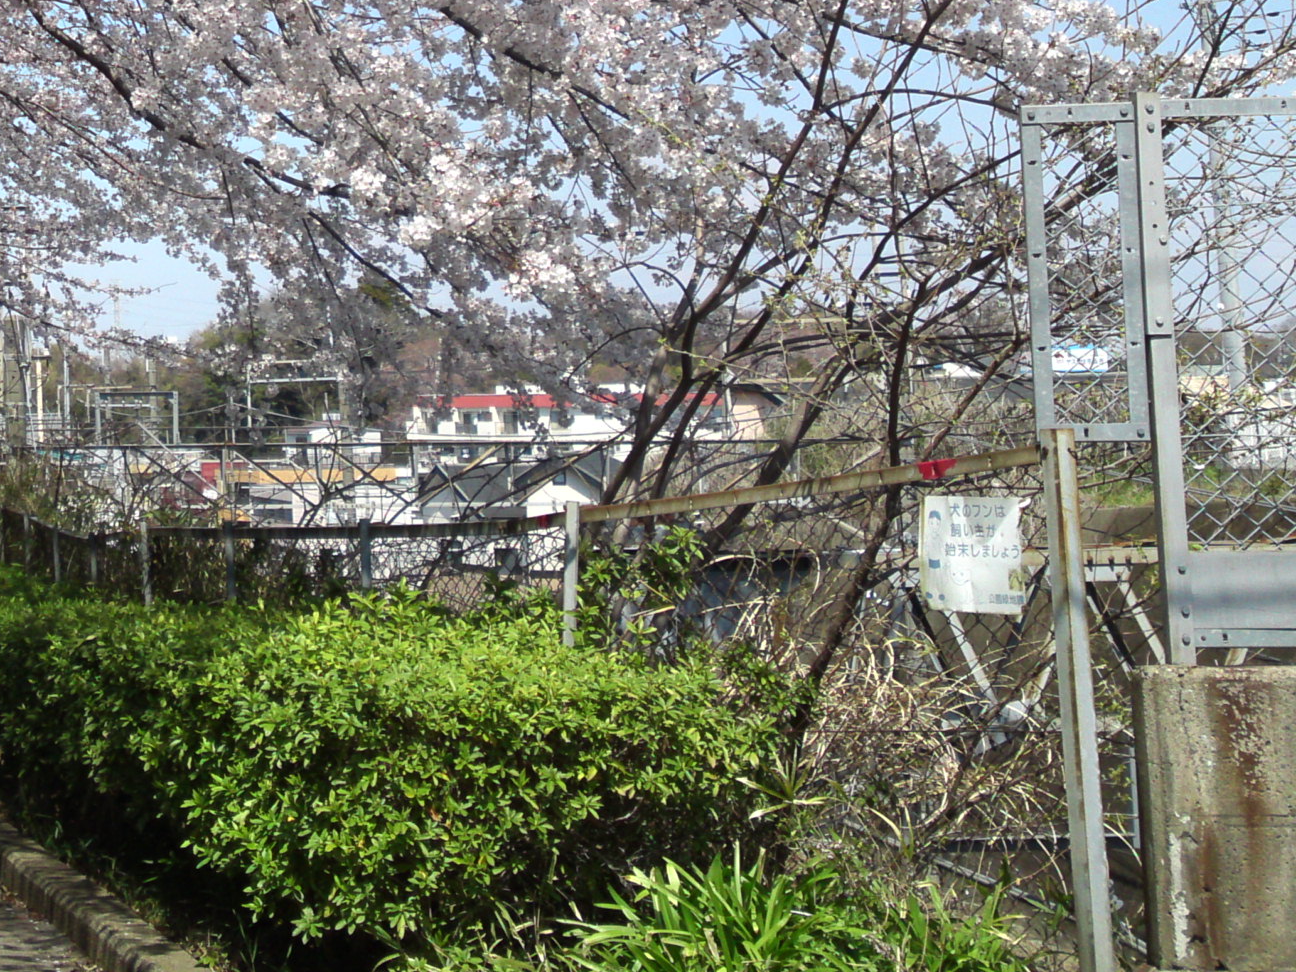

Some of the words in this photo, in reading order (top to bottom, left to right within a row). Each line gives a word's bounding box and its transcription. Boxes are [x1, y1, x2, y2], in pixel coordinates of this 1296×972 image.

[950, 504, 1006, 518] 犬のフンは
[944, 542, 1020, 559] 始末しましょう
